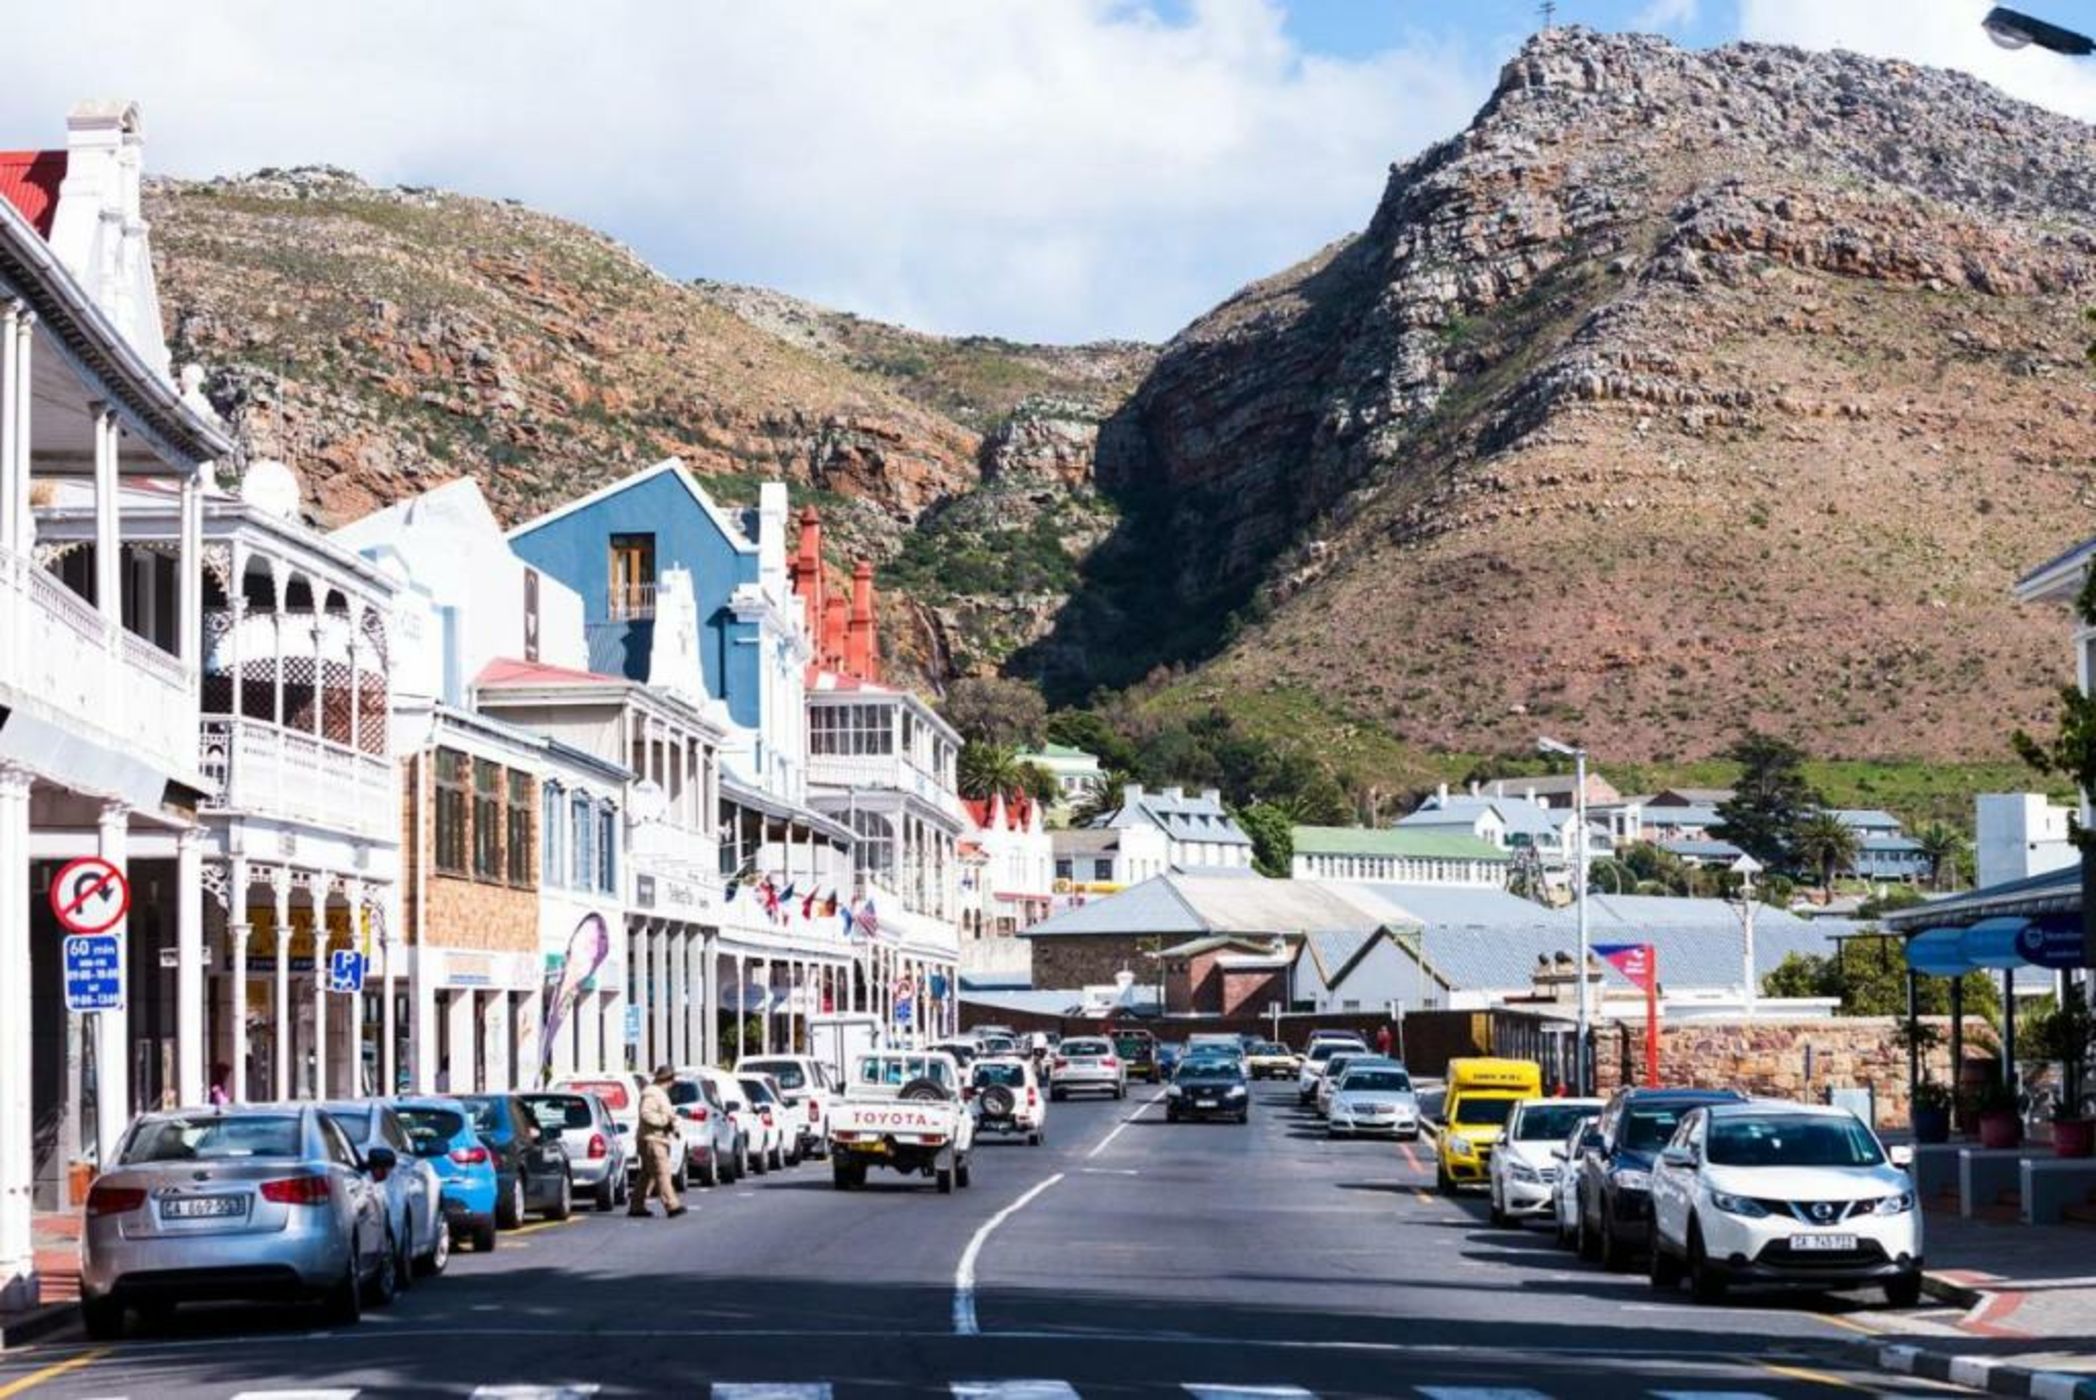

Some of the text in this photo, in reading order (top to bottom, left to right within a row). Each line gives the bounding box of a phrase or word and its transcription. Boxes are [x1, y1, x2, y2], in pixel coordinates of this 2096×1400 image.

[70, 940, 116, 957] 60 min
[853, 1111, 927, 1126] TOYOTA
